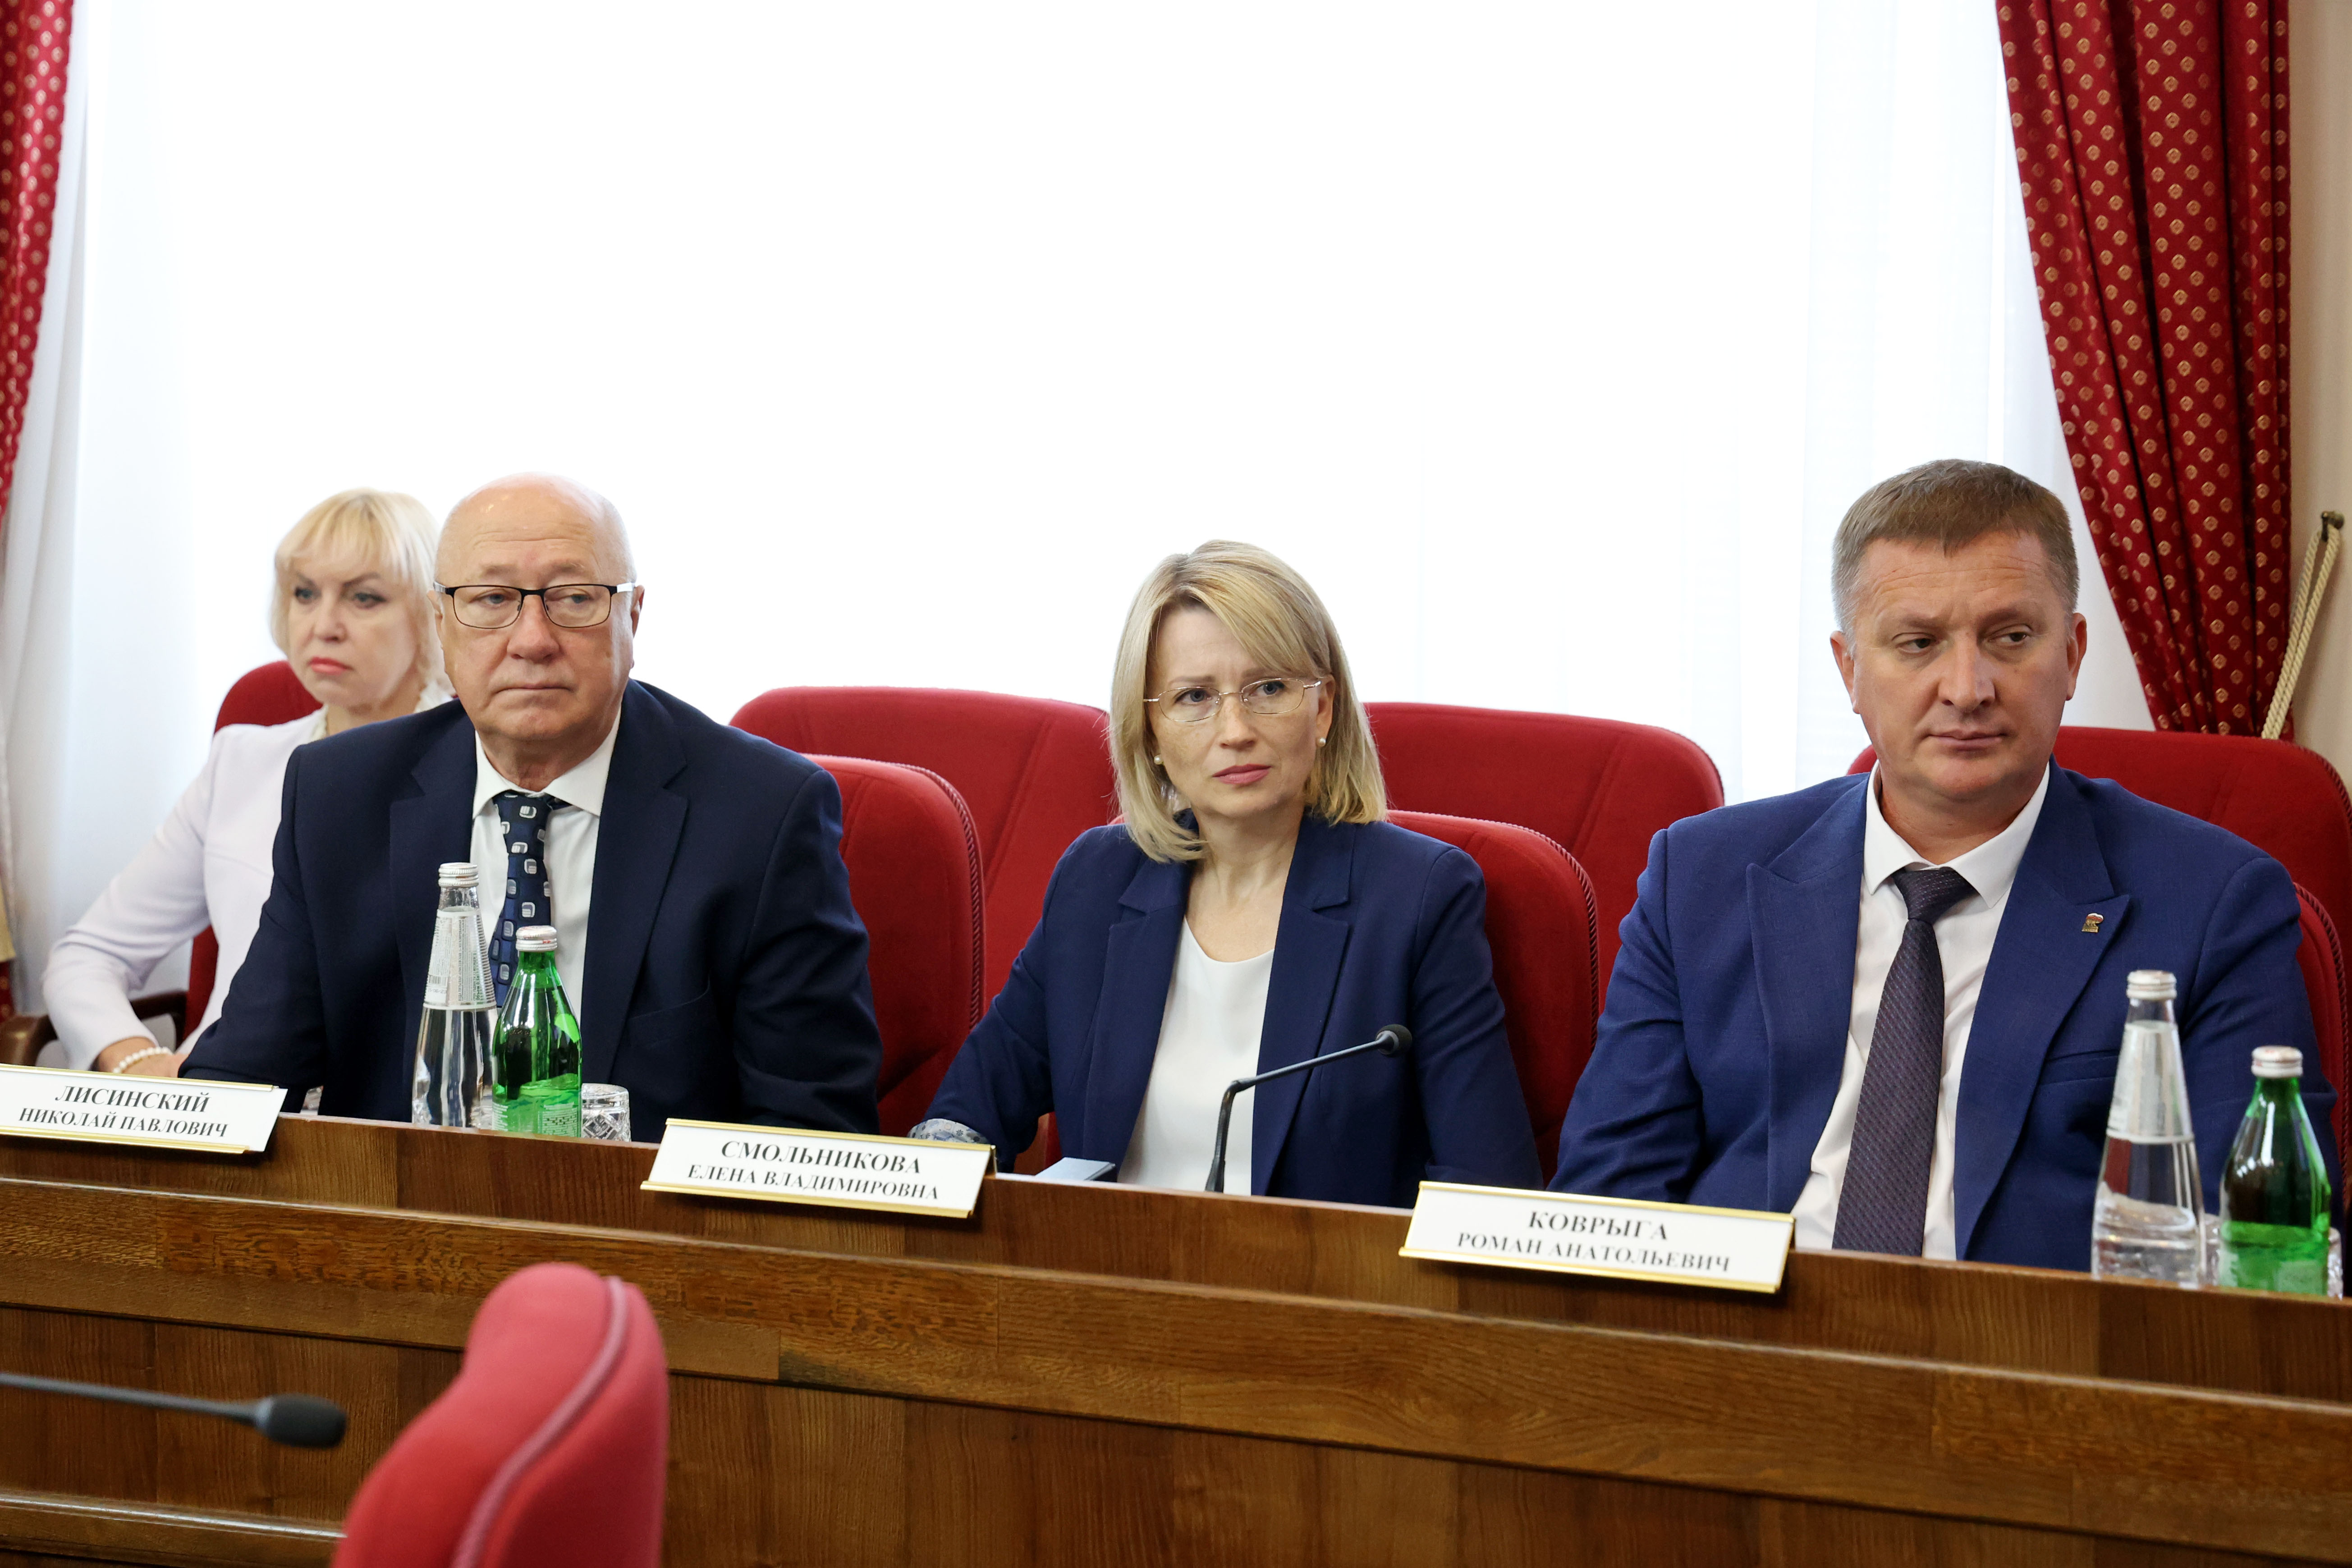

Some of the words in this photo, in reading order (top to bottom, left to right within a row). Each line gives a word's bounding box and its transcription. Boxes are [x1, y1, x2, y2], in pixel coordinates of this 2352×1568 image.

[55, 1086, 211, 1112] ЛИСИНСКИЙ
[19, 1108, 117, 1129] НИКОЛАЙ
[120, 1116, 229, 1137] ПАВЛОВИЧ
[721, 1140, 921, 1174] СМОЛЬНИКОВА
[688, 1164, 756, 1184] ЕЛЕНА
[764, 1172, 938, 1200] ВЛАДИМИРОВНА
[1527, 1211, 1668, 1241] КОВРЫГА
[1458, 1232, 1541, 1255] РОМАН
[1548, 1242, 1731, 1272] АНАТОЛЬЕВИЧ
